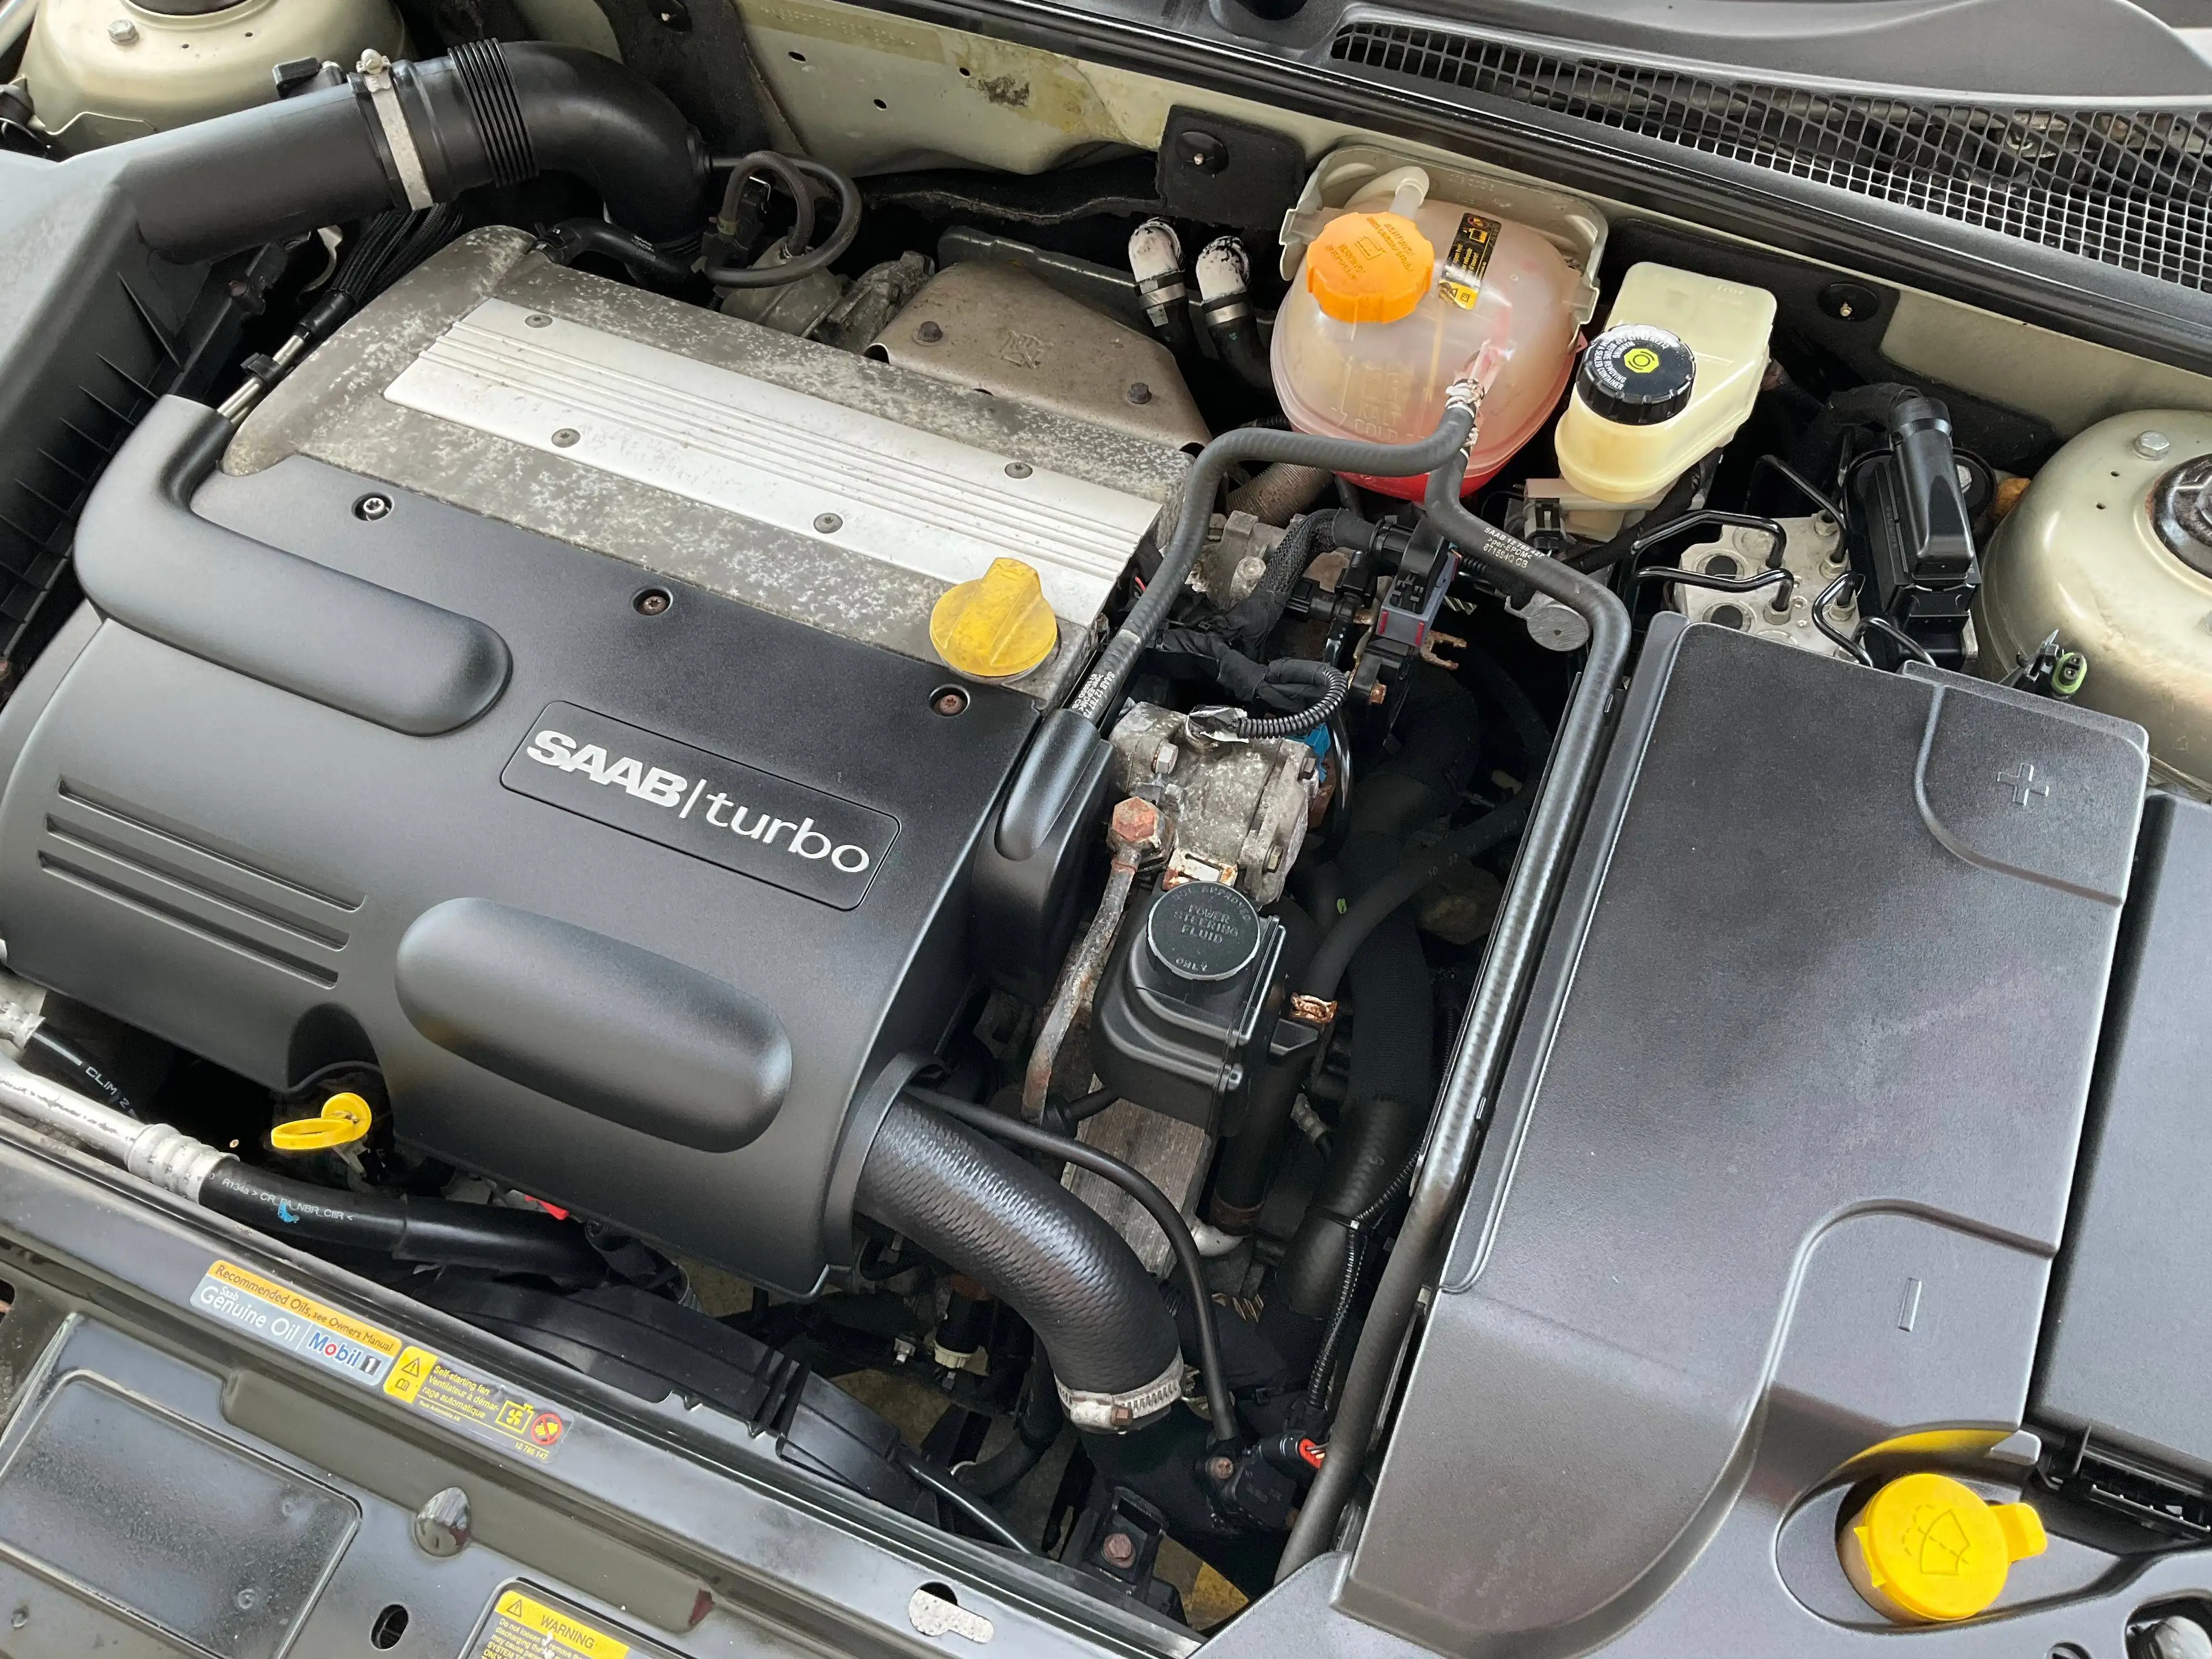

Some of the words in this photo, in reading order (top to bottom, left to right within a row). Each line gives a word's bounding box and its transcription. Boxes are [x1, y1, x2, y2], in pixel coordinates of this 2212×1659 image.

[1594, 350, 1603, 368] SEALED
[1603, 342, 1618, 361] BEFORE
[1597, 365, 1624, 391] CONTAINER
[1604, 360, 1627, 383] REMOVING
[1484, 527, 1506, 540] SAAB
[1100, 671, 1115, 690] SAAB
[1094, 688, 1104, 698] 12
[527, 730, 687, 808] SAAB
[706, 791, 869, 873] turbo
[1174, 911, 1238, 937] STEERING
[1188, 904, 1230, 925] POWER
[1181, 924, 1223, 944] FLUID
[1176, 957, 1207, 972] ONLY
[85, 1066, 118, 1096] CLIM
[222, 1178, 249, 1195] R134a
[219, 1286, 240, 1301] Saab
[200, 1286, 267, 1328] Genuine
[271, 1317, 301, 1342] Oil
[215, 1265, 290, 1305] Recommended
[290, 1298, 310, 1317] Oils,
[312, 1312, 327, 1323] see
[329, 1317, 362, 1339] Owners
[362, 1332, 394, 1352] Manual
[308, 1331, 362, 1368] Mobil
[433, 1365, 478, 1391] Self-starting
[478, 1384, 491, 1396] fan
[422, 1387, 438, 1399] rage
[440, 1395, 486, 1419] automatique
[429, 1375, 467, 1397] Ventilateur
[467, 1392, 473, 1400] à
[473, 1394, 499, 1411] démar-
[536, 1451, 548, 1461] 147
[491, 1634, 505, 1645] may
[505, 1641, 524, 1654] cause
[495, 1627, 532, 1650] discharging
[499, 1618, 509, 1628] Do
[512, 1623, 521, 1633] not
[520, 1626, 541, 1643] loosen
[548, 1643, 572, 1658] remove
[540, 1615, 595, 1650] WARNING
[487, 1641, 517, 1658] SYSTEM
